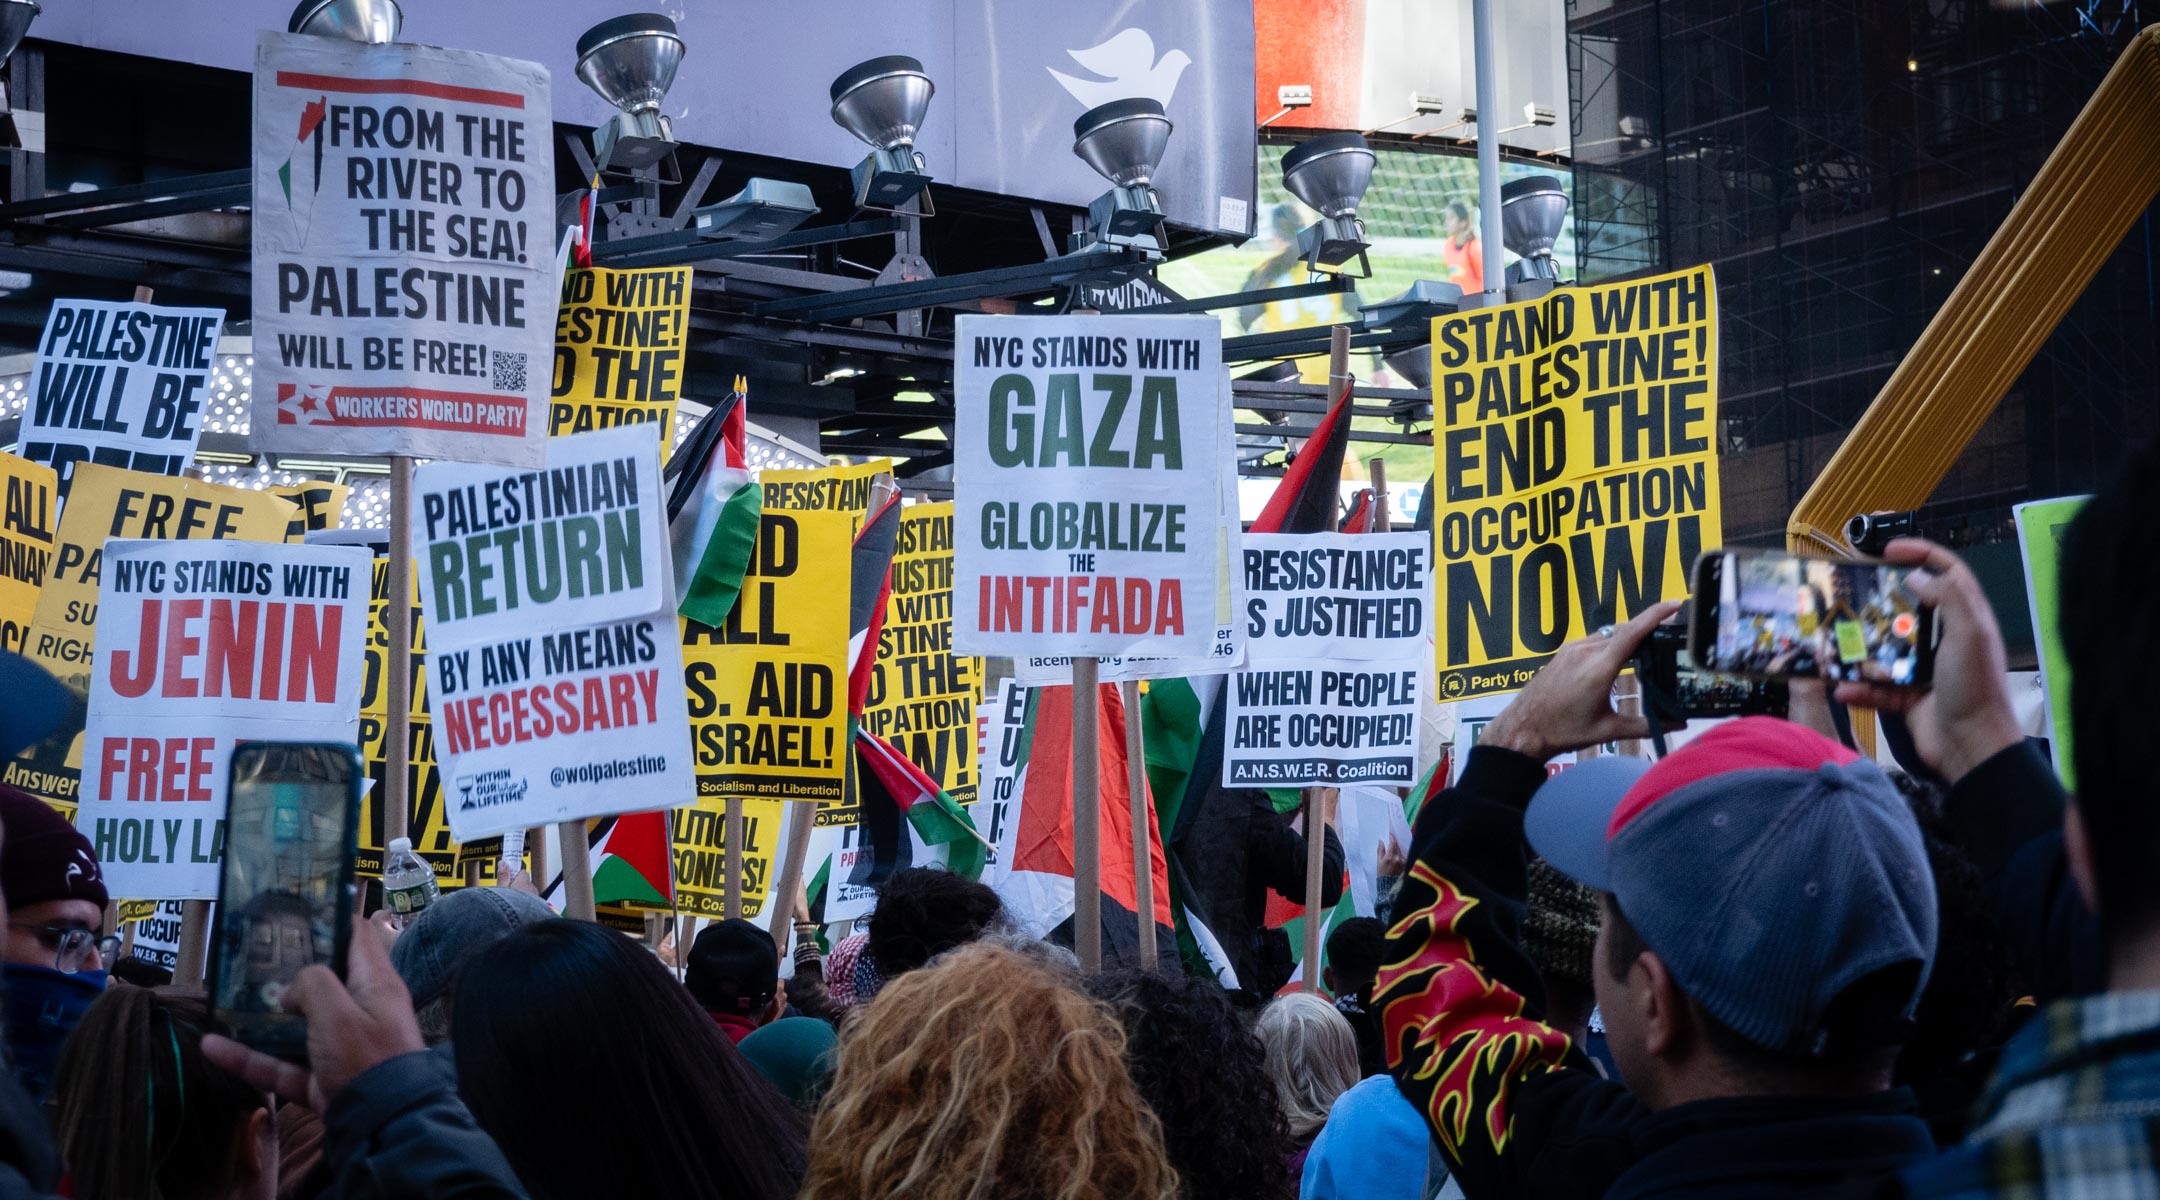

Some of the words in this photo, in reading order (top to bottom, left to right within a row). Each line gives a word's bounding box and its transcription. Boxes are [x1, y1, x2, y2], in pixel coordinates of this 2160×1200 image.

[331, 106, 443, 149] FROM
[456, 114, 525, 162] THE
[348, 157, 463, 206] RIVER
[474, 167, 526, 212] TO
[361, 209, 436, 254] THE
[447, 214, 527, 263] SEA!
[279, 263, 526, 328] PALESTINE
[606, 271, 685, 307] WITH
[45, 308, 218, 369] PALESTINE
[1441, 294, 1575, 368] STAND
[1591, 272, 1706, 335] WITH
[278, 333, 352, 370] WILL
[364, 337, 404, 372] BE
[414, 340, 487, 378] FREE!
[592, 347, 680, 402] THE
[974, 336, 1023, 368] NYC
[1032, 337, 1127, 369] STANDS
[1136, 338, 1200, 371] WITH
[1444, 325, 1706, 426] PALESTINE!
[34, 362, 129, 434] WILL
[142, 373, 205, 441] BE
[334, 396, 417, 421] WORKERS
[421, 398, 474, 424] WORLD
[476, 402, 524, 428] PARTY
[987, 374, 1183, 470] GAZA
[1446, 406, 1567, 503] END
[1583, 379, 1708, 468] THE
[4, 475, 53, 544] ALL
[423, 457, 638, 540] PALESTINIAN
[1442, 462, 1706, 560] OCCUPATION
[980, 501, 1186, 552] GLOBALIZE
[115, 559, 165, 593] NYC
[174, 561, 272, 596] STANDS
[283, 564, 350, 600] WITH
[429, 508, 644, 624] RETURN
[1068, 554, 1095, 573] THE
[1243, 548, 1423, 591] RESISTANCE
[978, 576, 1185, 636] INTIFADA
[1274, 596, 1422, 638] JUSTIFIED
[1447, 515, 1701, 667] NOW!
[109, 599, 343, 704] JENIN
[439, 653, 470, 695] BY
[482, 640, 531, 687] ANY
[543, 622, 656, 678] MEANS
[896, 652, 971, 699] THE
[746, 662, 834, 719] AID
[1238, 670, 1312, 706] WHEN
[1321, 671, 1415, 706] PEOPLE
[1471, 674, 1510, 690] Party
[1513, 669, 1535, 684] for
[443, 668, 659, 755] NECESSARY
[1233, 714, 1281, 749] ARE
[1288, 713, 1412, 749] OCCUPIED!
[3, 761, 80, 797] Answer
[99, 737, 213, 802] FREE
[475, 768, 511, 784] WITHIN
[476, 783, 497, 796] OUR
[551, 755, 666, 788] @wolpalestine
[701, 782, 756, 794] Socialism
[758, 783, 780, 793] and
[783, 783, 840, 796] Liberation
[1235, 762, 1332, 779] A.N.S.W.E.R.
[1337, 762, 1408, 778] Coalition
[477, 791, 524, 808] LIFETIME
[831, 813, 856, 824] Party
[97, 818, 183, 863] HOLY
